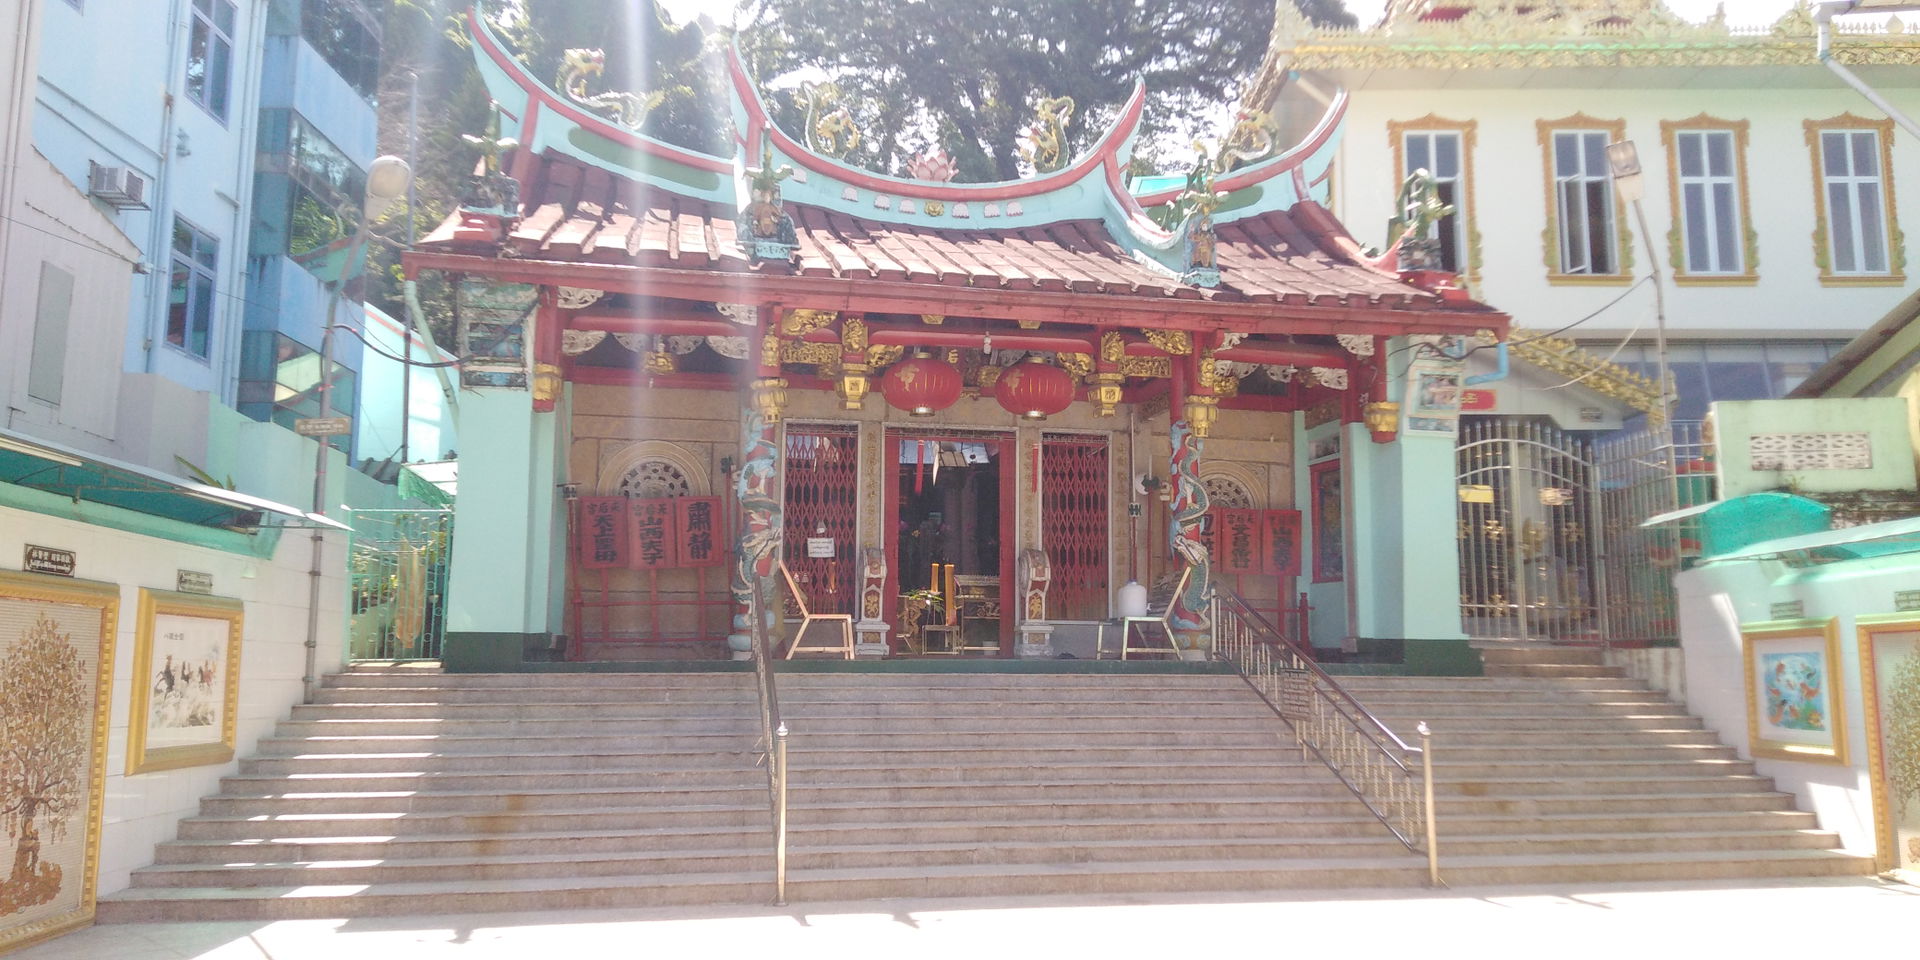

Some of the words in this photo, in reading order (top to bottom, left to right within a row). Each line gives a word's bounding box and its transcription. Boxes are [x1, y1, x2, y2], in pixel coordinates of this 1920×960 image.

[639, 516, 664, 565] 山西夫子
[687, 502, 713, 560] 肅靜
